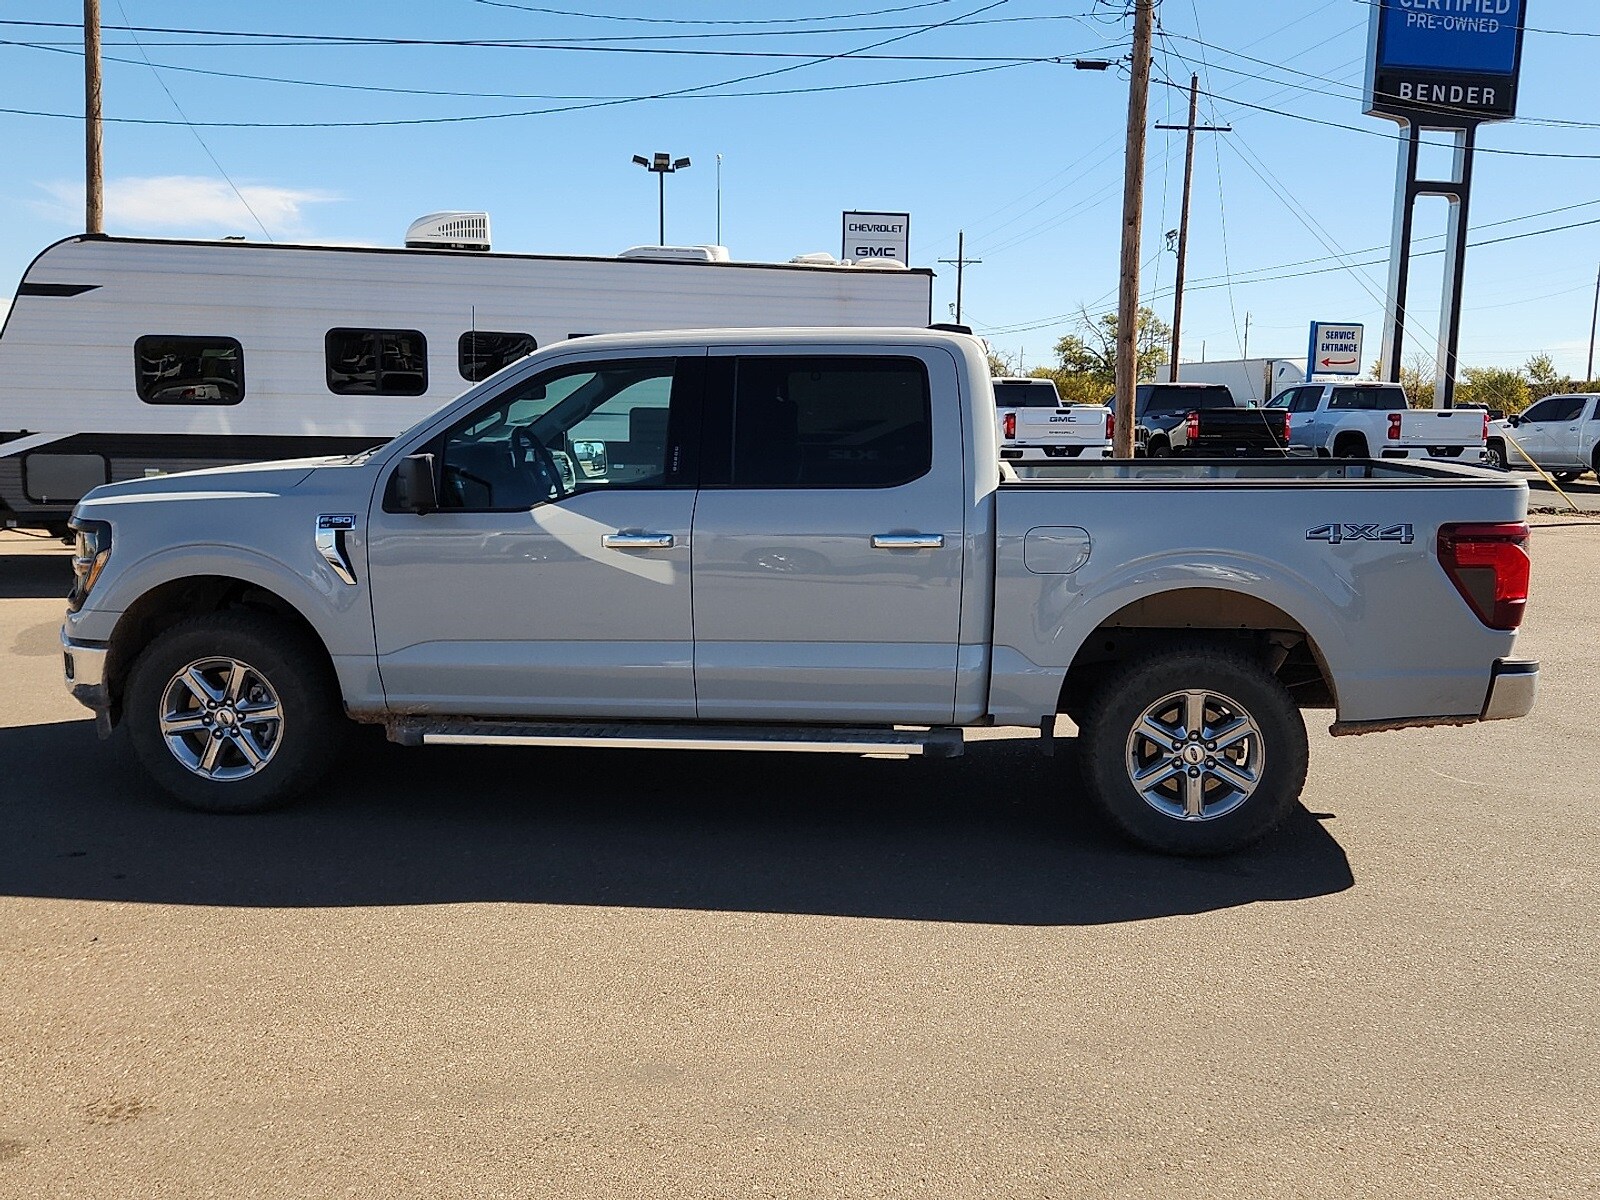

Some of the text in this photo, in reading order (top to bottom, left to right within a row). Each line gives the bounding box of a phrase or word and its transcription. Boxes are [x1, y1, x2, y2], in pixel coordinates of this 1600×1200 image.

[1406, 13, 1500, 33] PRE-OWNED
[1400, 82, 1496, 105] BENDER
[848, 223, 903, 233] CHEVROLET
[855, 246, 896, 257] GMC
[1325, 330, 1356, 340] SERVICE
[1321, 343, 1358, 352] ENTRANCE
